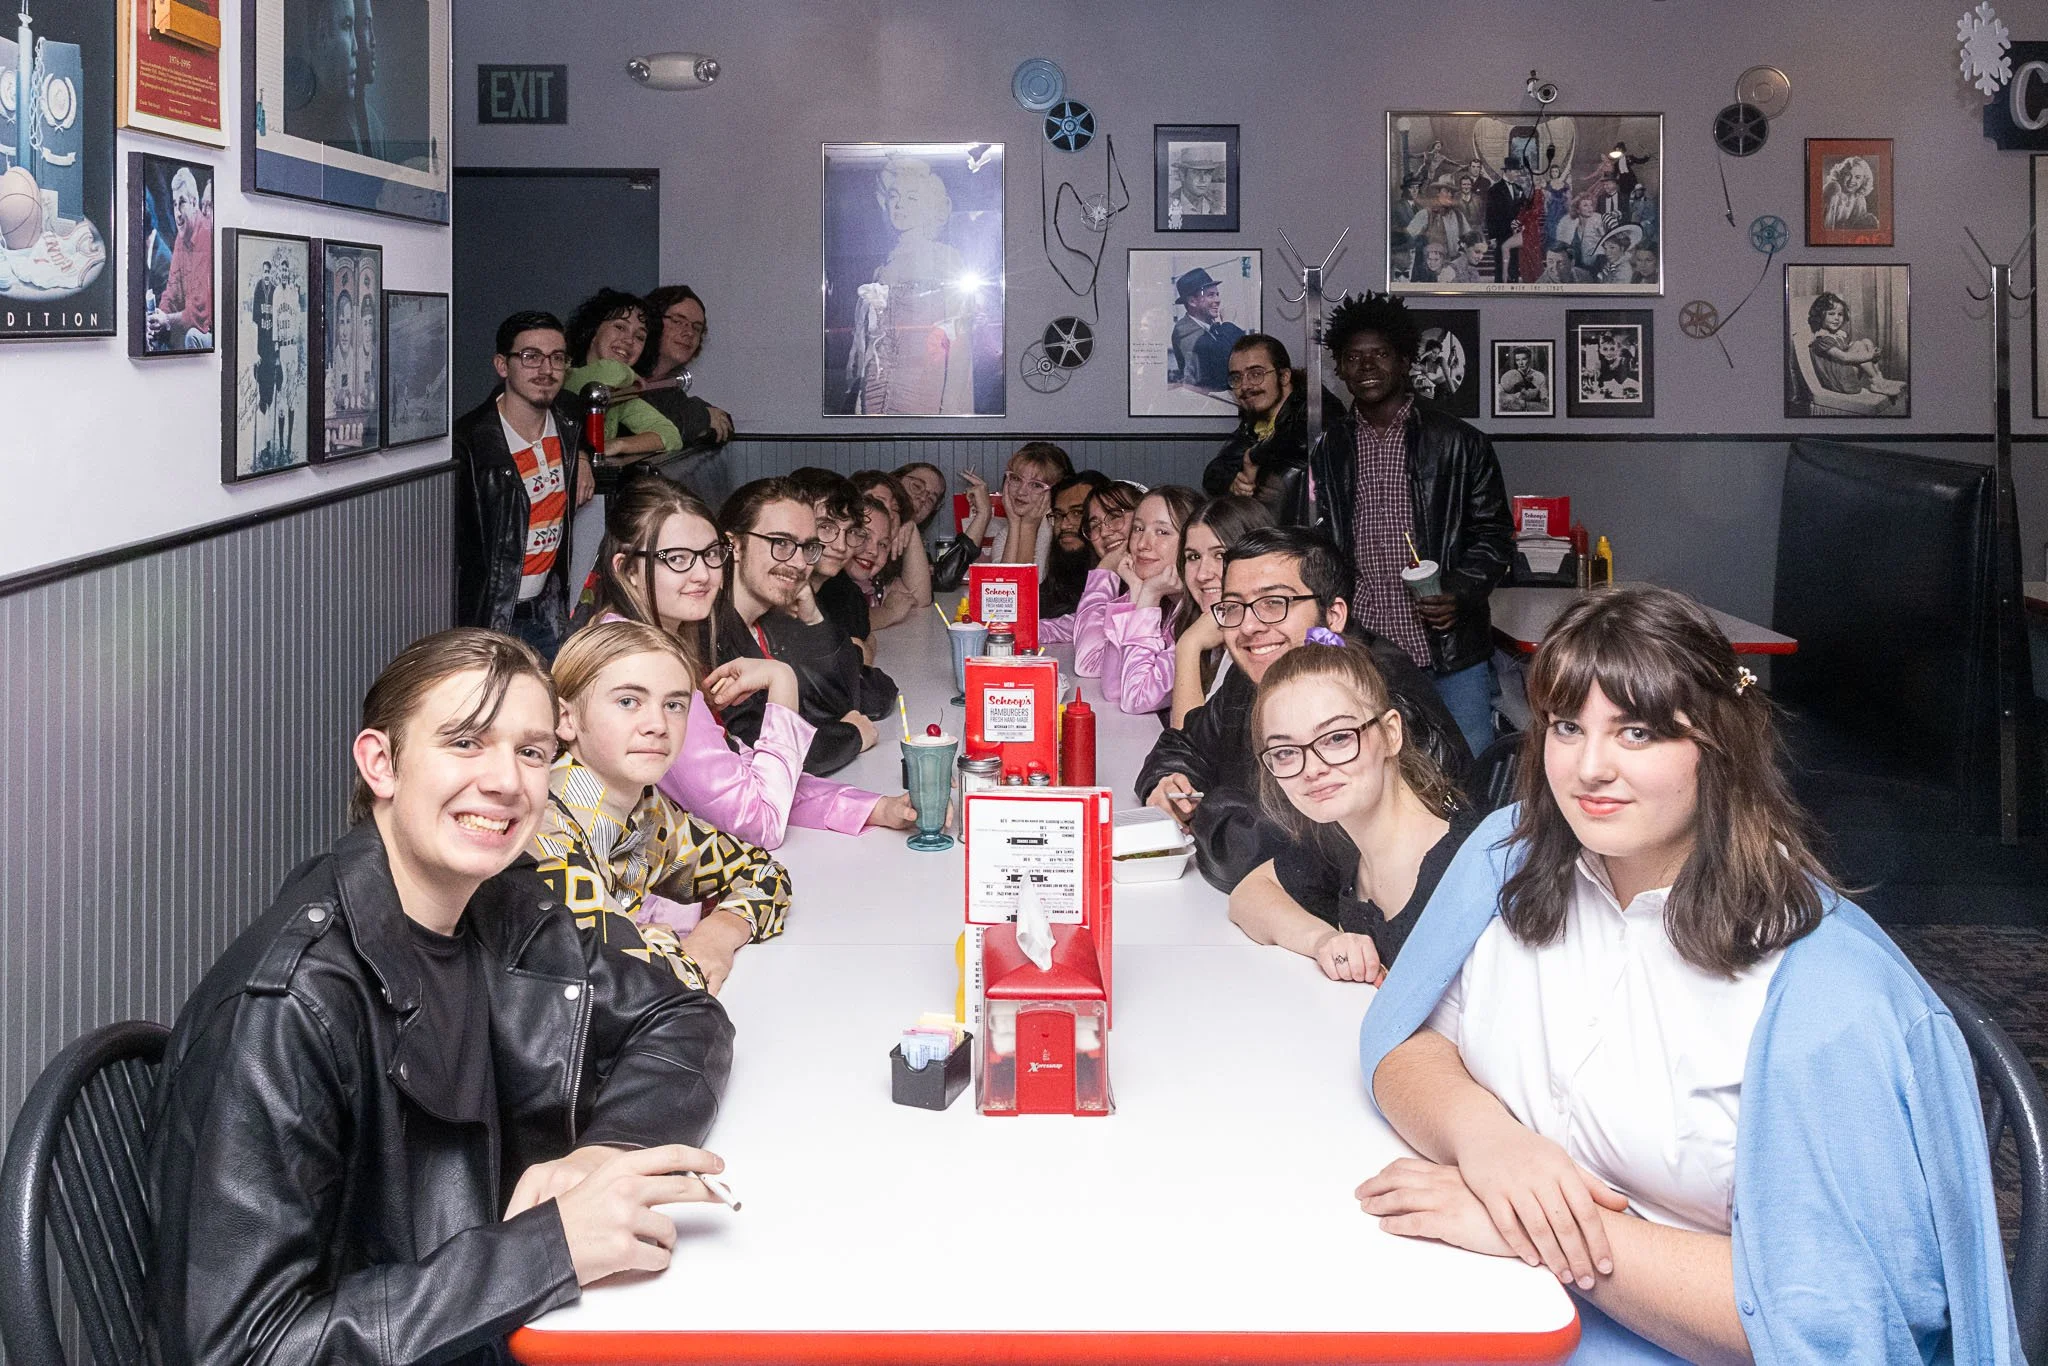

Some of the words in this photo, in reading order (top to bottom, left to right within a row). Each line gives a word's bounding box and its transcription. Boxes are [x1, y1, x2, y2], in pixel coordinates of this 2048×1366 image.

[491, 71, 554, 118] EXIT
[7, 312, 98, 327] DITION
[985, 588, 1015, 597] Schoop's
[988, 696, 1031, 707] Schoop's
[990, 708, 1029, 716] HAMBURGERS
